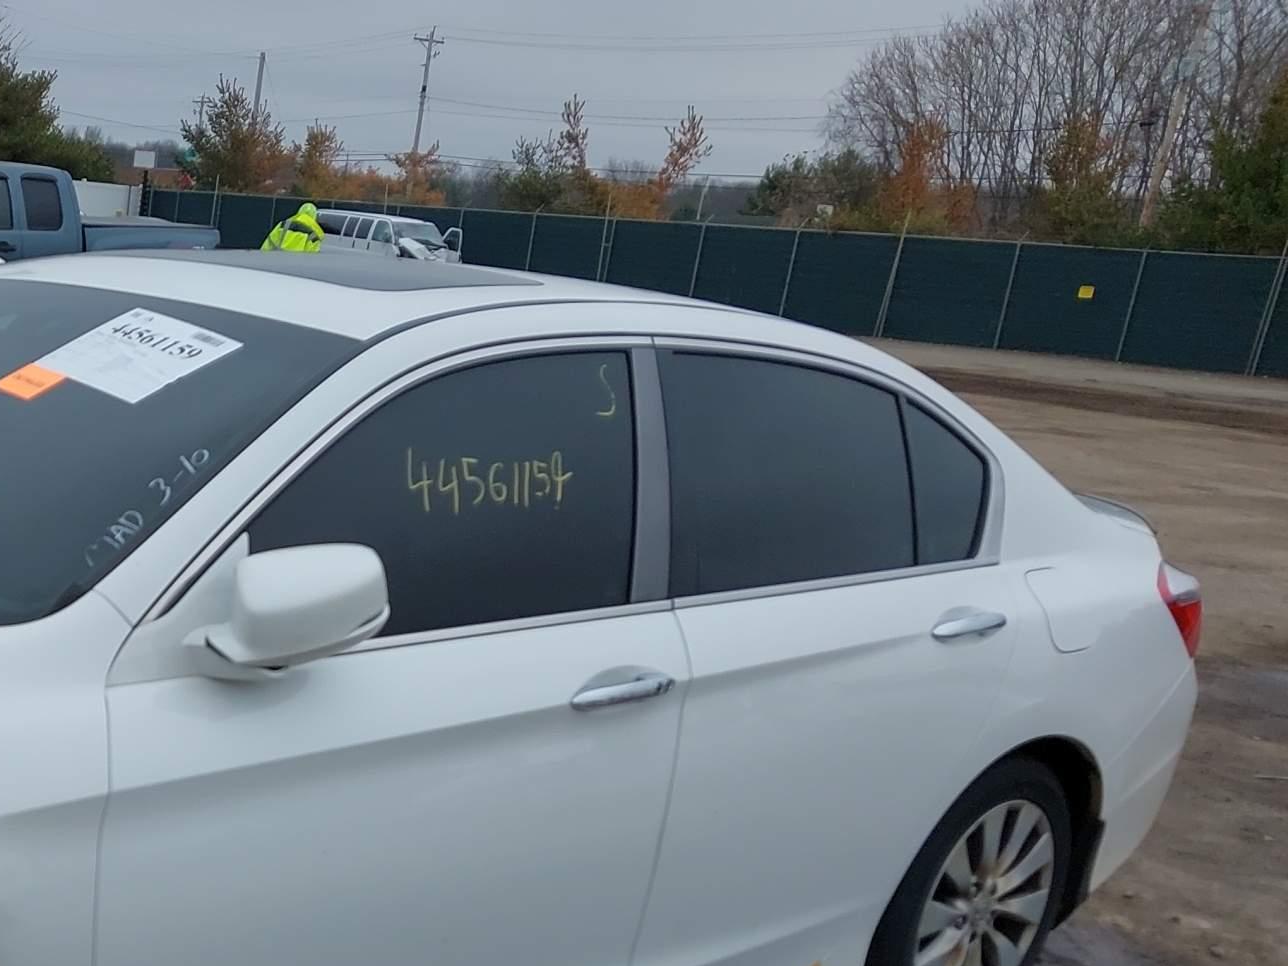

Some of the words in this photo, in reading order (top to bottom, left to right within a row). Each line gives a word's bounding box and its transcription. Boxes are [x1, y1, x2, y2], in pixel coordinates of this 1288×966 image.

[112, 323, 202, 360] 44561159
[148, 448, 210, 506] 3-10
[408, 447, 573, 516] 44561159
